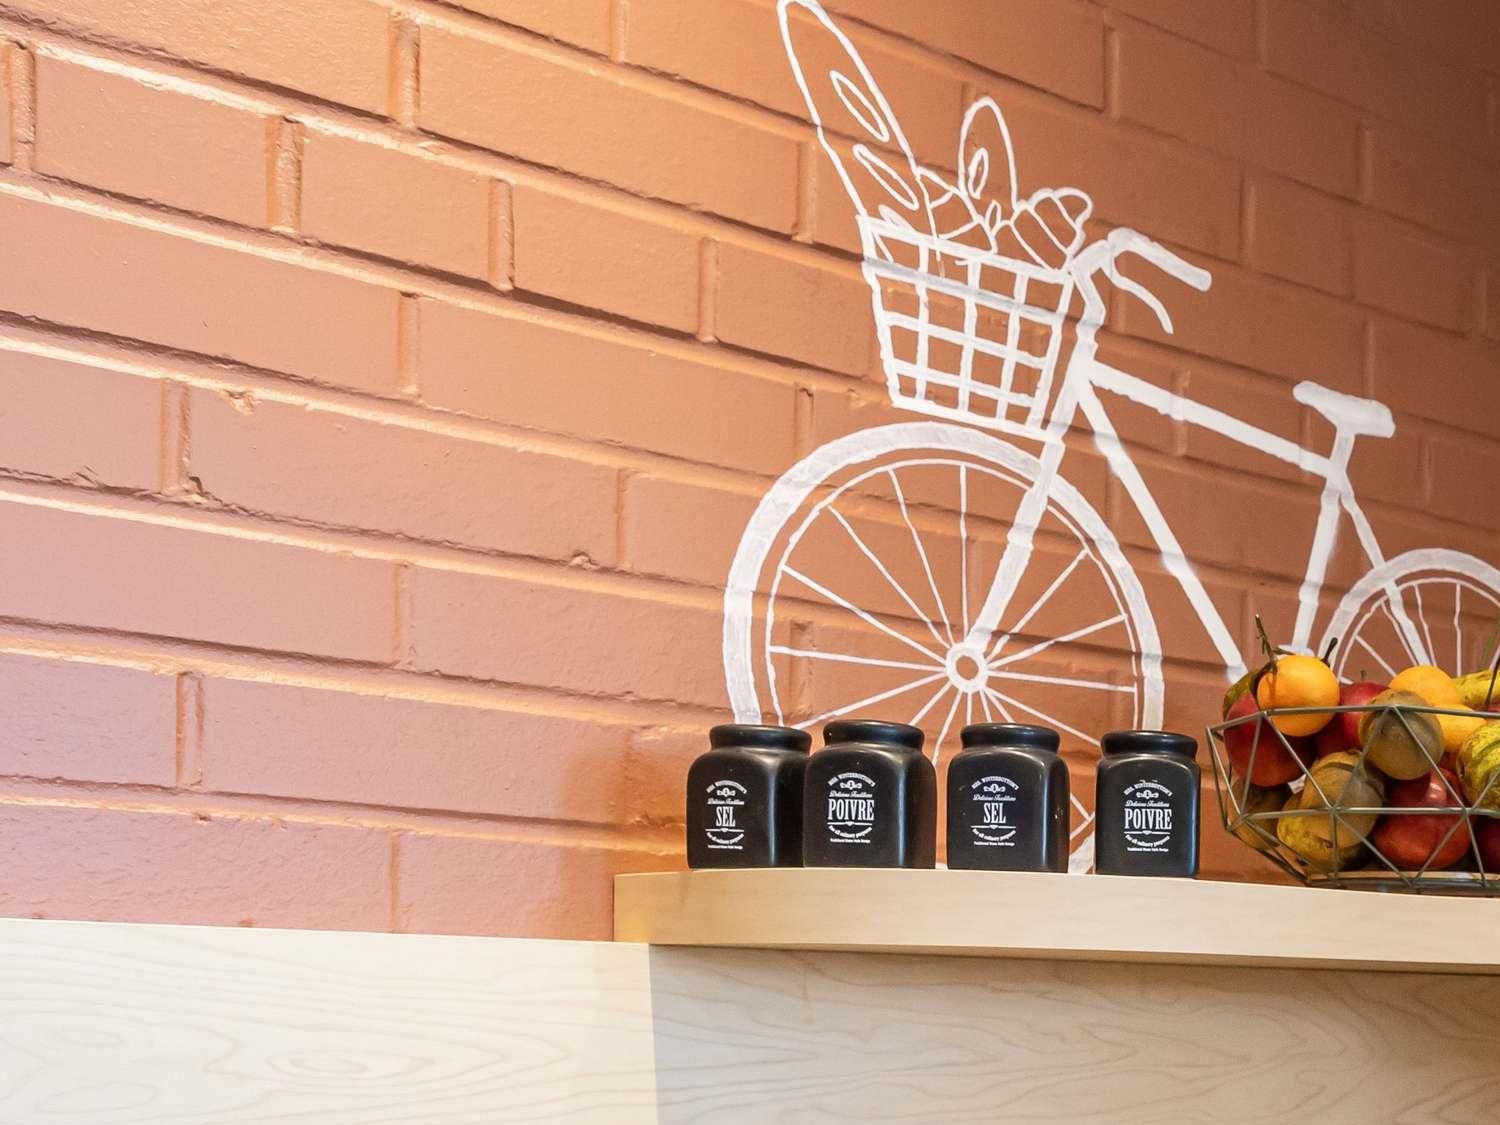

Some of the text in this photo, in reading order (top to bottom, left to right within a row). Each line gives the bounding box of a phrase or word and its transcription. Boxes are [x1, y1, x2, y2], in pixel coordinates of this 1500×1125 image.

[716, 806, 736, 827] SEL
[827, 798, 875, 821] POIVRE
[983, 802, 1007, 824] SEL
[1124, 808, 1173, 830] POIVRE
